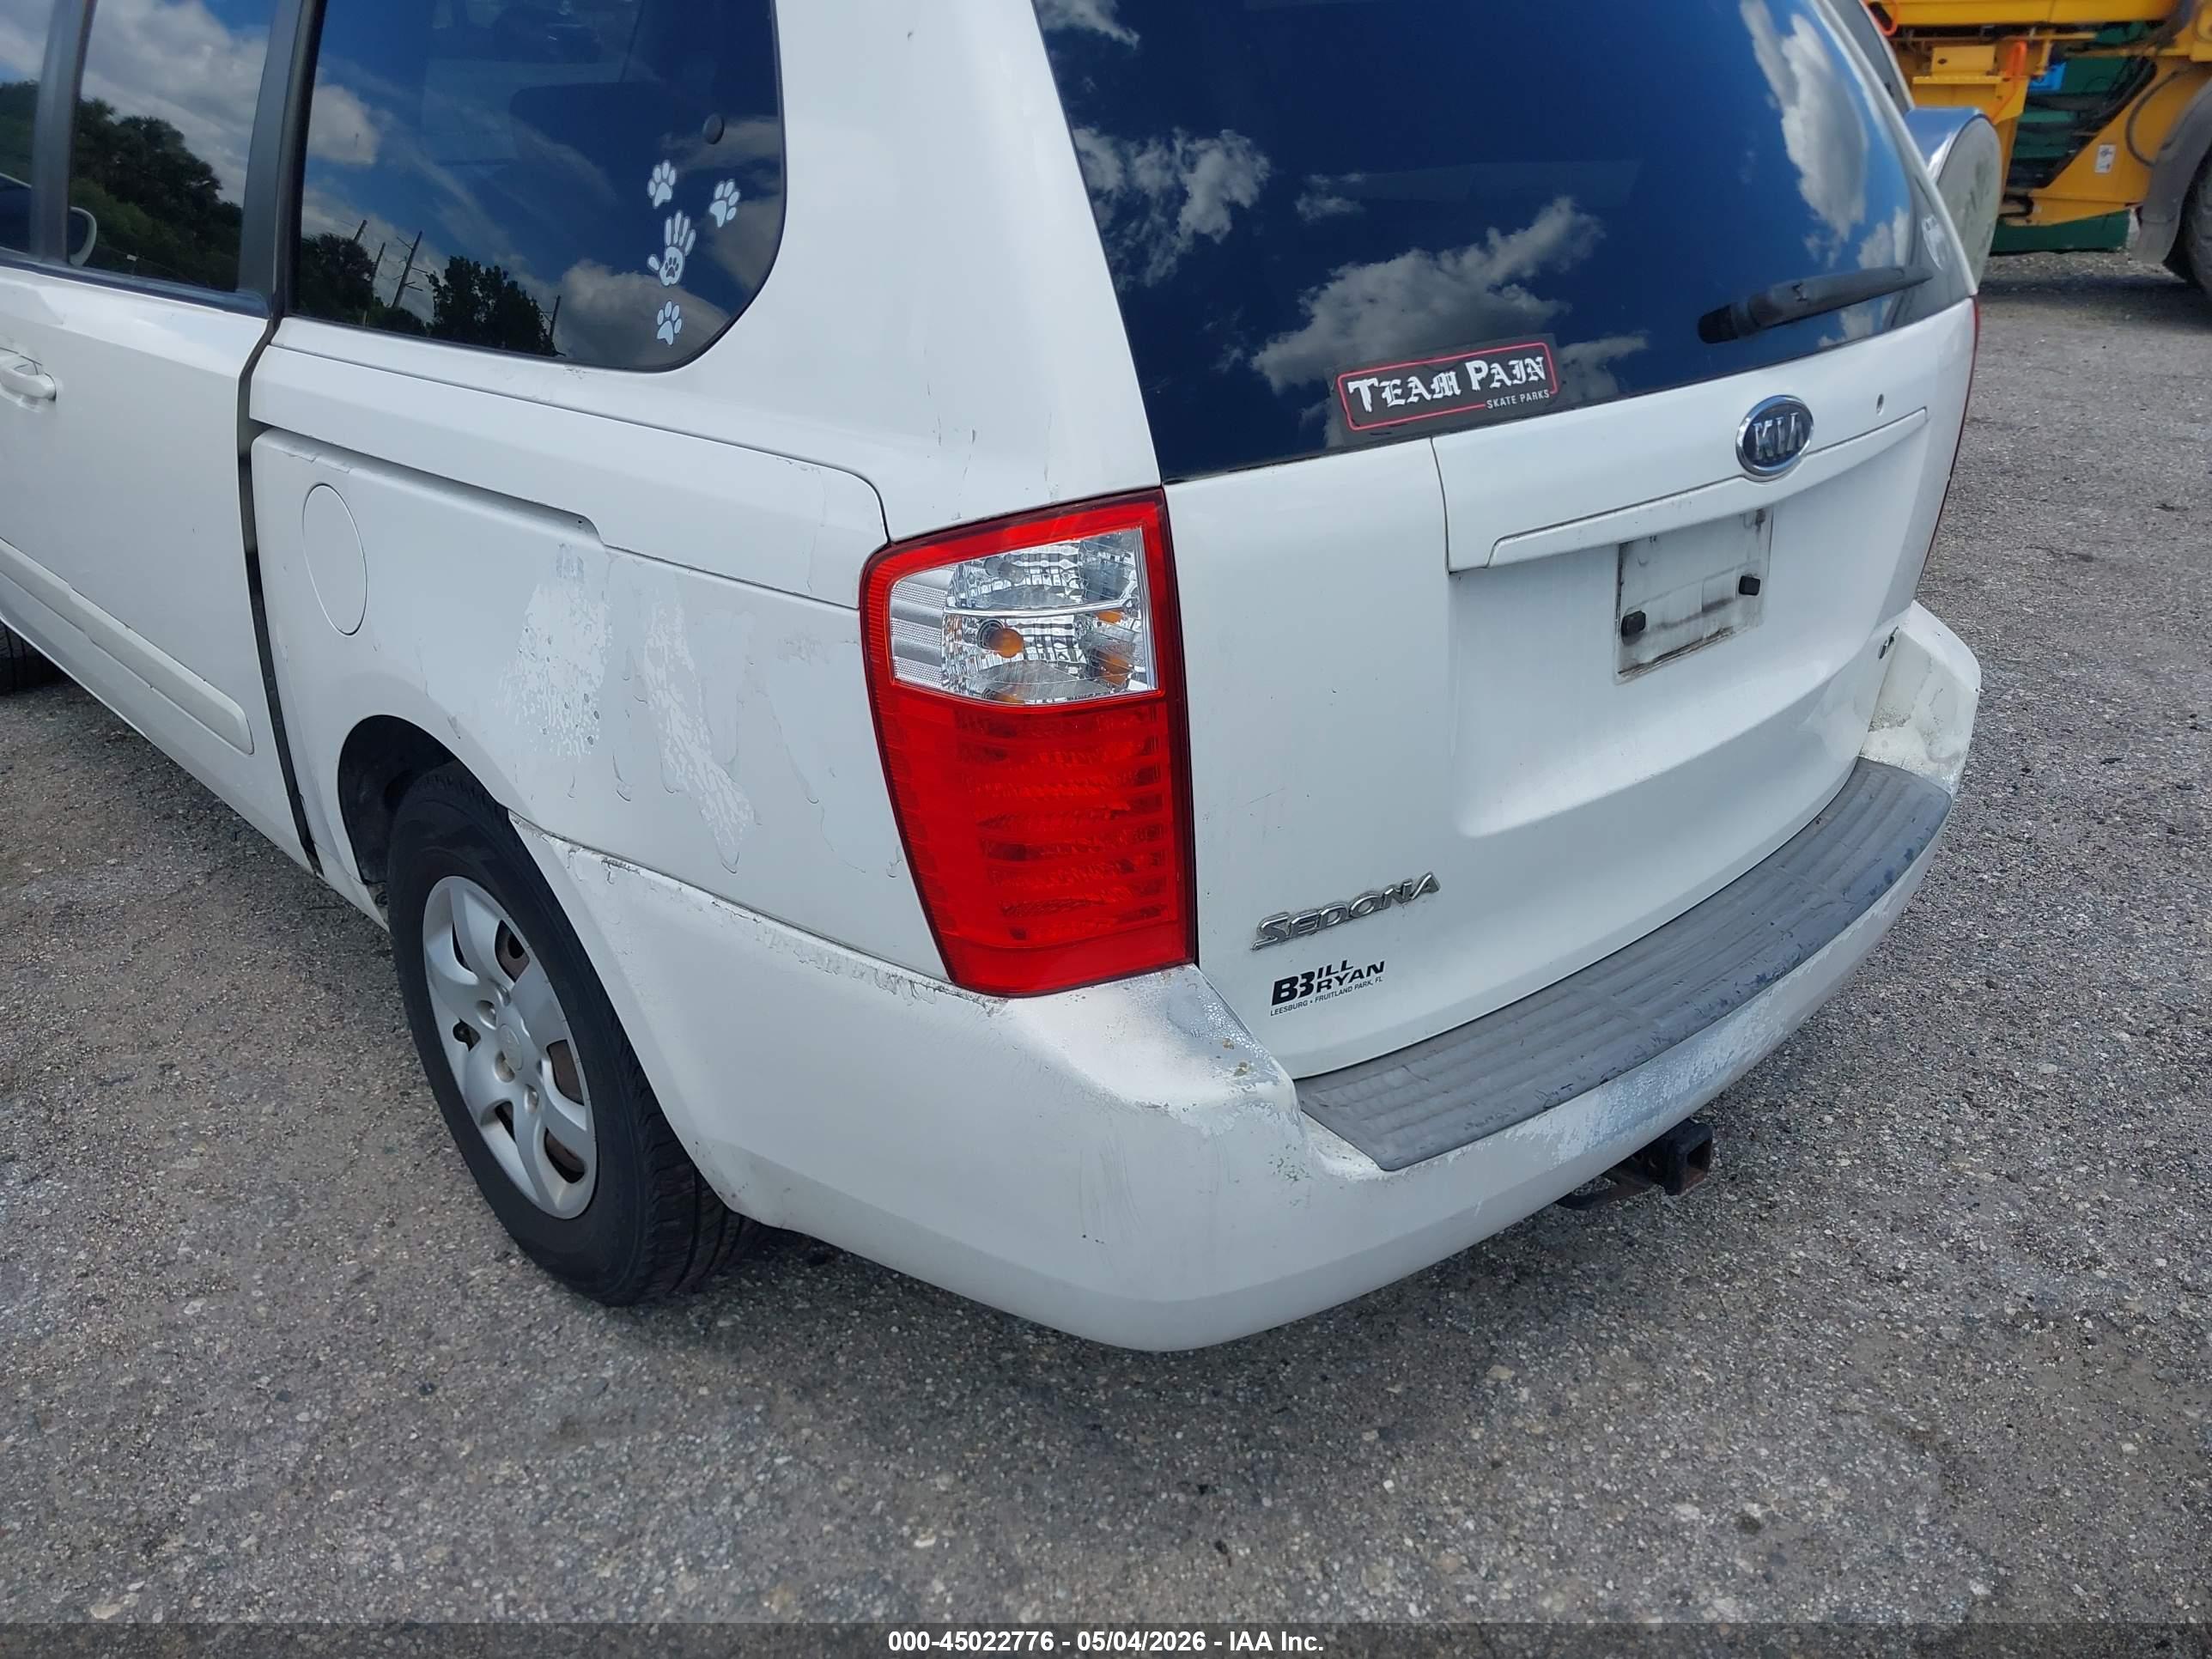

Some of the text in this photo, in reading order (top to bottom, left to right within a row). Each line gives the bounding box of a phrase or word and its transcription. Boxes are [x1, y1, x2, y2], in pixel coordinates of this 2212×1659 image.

[1347, 356, 1547, 413] TEAM PAIN
[1486, 389, 1550, 410] SKATE PARKS
[1753, 412, 1806, 461] KIA
[1250, 872, 1441, 951] SEDONA
[1270, 975, 1383, 1017] LEESBURG FRUITLAND PARK, FL
